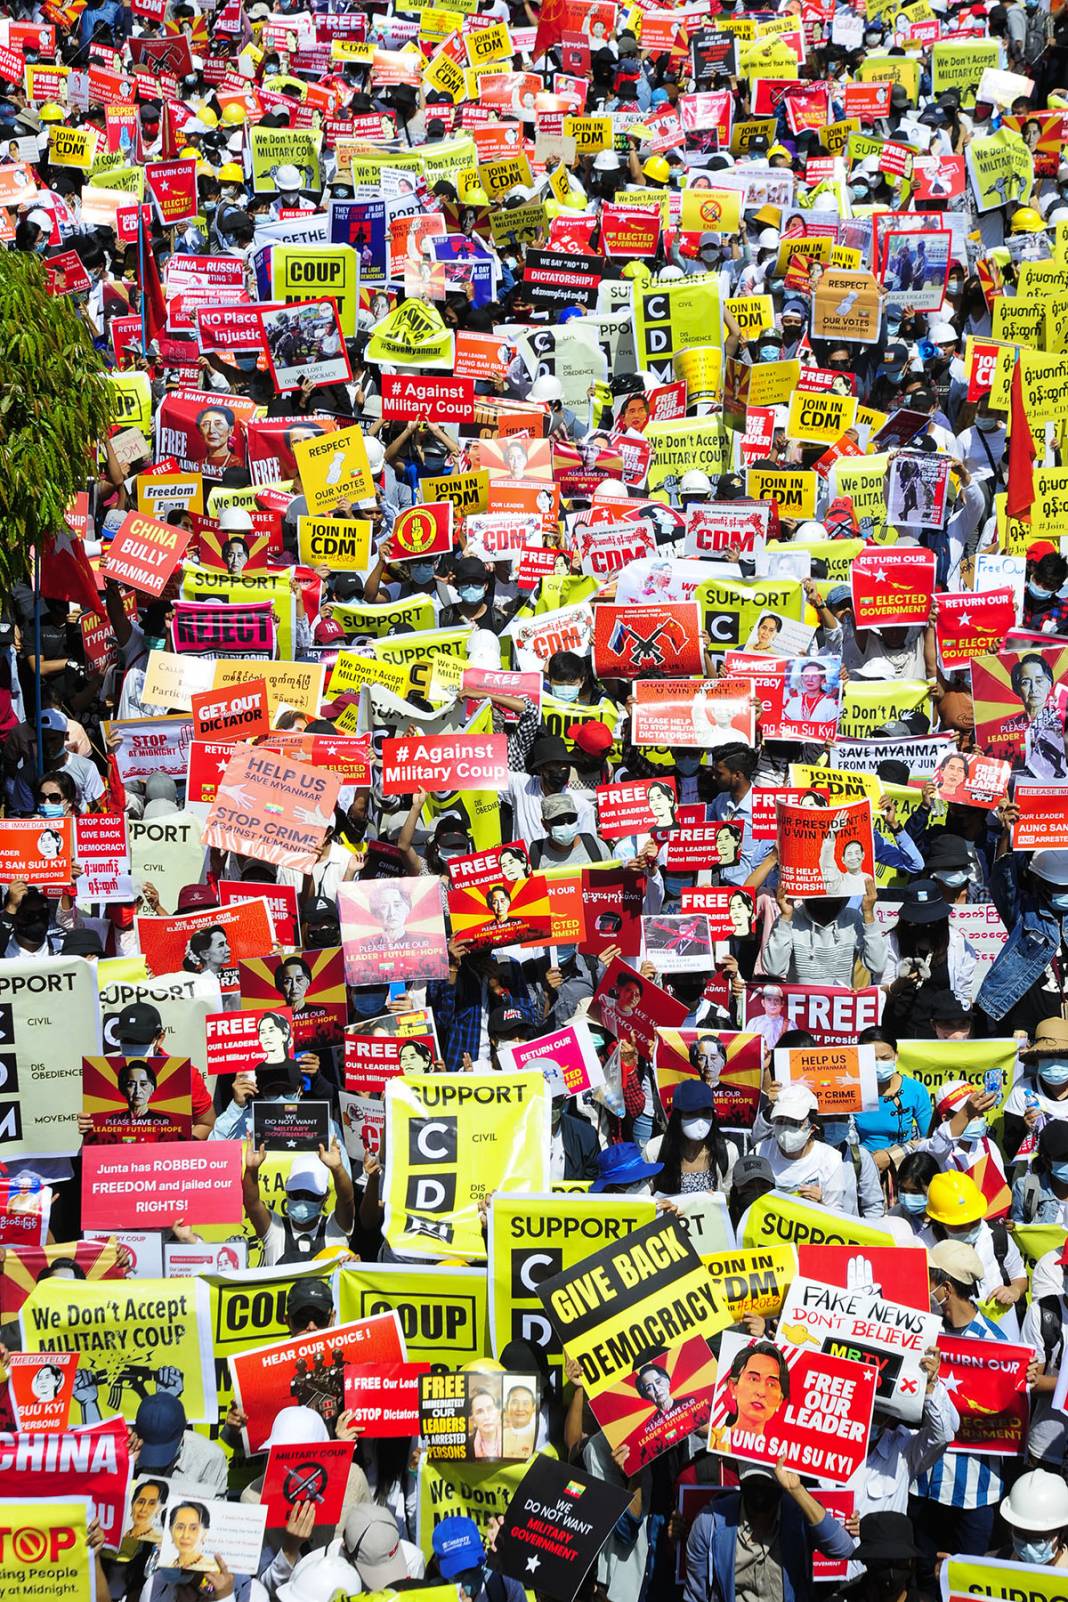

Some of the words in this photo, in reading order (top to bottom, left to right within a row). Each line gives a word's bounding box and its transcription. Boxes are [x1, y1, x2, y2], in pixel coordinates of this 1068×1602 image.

[316, 15, 359, 29] FREE
[491, 30, 501, 39] IN
[476, 39, 501, 55] CDM
[936, 58, 949, 67] We
[972, 54, 996, 65] Accept
[939, 67, 975, 79] MILITARY
[355, 117, 379, 127] FREE
[76, 135, 86, 144] IN
[255, 134, 269, 146] We
[151, 169, 175, 178] RETURN
[490, 170, 523, 189] CDM
[618, 232, 653, 241] ELECTED
[169, 260, 197, 271] CHINA
[207, 262, 241, 273] RUSSIA
[290, 263, 342, 282] COUP
[531, 272, 593, 285] DICTATORSHIP!
[828, 280, 868, 289] RESPECT
[648, 297, 665, 318] C
[201, 313, 221, 325] NO
[225, 311, 258, 323] Place
[842, 318, 869, 327] VOTES
[650, 332, 667, 350] D
[800, 371, 832, 384] FREE
[405, 383, 464, 398] Against
[655, 391, 678, 404] FREE
[384, 398, 431, 412] Military
[434, 400, 473, 415] Coup
[161, 427, 187, 460] FREE
[309, 437, 351, 458] RESPECT
[696, 434, 729, 448] Accept
[650, 451, 699, 465] MILITARY
[252, 457, 281, 485] FREE
[147, 486, 194, 496] Freedom
[315, 489, 334, 500] OUR
[336, 479, 365, 496] VOTES
[130, 519, 178, 549] CHINA
[484, 529, 526, 550] CDM
[697, 530, 754, 551] CDM
[120, 539, 167, 565] BULLY
[521, 552, 554, 563] FREE
[105, 558, 164, 588] MYANMAR
[196, 572, 279, 587] SUPPORT
[876, 594, 927, 605] ELECTED
[946, 598, 984, 608] RETURN
[986, 595, 1008, 605] OUR
[860, 606, 927, 616] GOVERNMENT
[178, 611, 270, 644] REJECT
[533, 627, 580, 659] CDM
[199, 703, 230, 721] GET
[233, 693, 261, 712] OUT
[200, 709, 262, 733] DICTATOR
[779, 723, 798, 735] San
[133, 735, 167, 748] STOP
[414, 743, 493, 760] Against
[839, 746, 873, 759] SAVE
[386, 763, 450, 782] Military
[457, 764, 504, 783] Coup
[838, 761, 867, 770] FROM
[248, 757, 297, 782] HELP
[301, 771, 326, 792] US
[244, 773, 269, 785] SAVE
[271, 780, 321, 801] MYANMAR
[598, 787, 646, 805] FREE
[753, 794, 800, 807] FREE
[210, 821, 257, 840] AGAINST
[217, 807, 259, 827] STOP
[263, 822, 318, 848] CRIME
[799, 815, 857, 830] PRESIDENT
[1019, 824, 1047, 832] AUNG
[78, 843, 125, 851] DEMOCRACY
[451, 856, 497, 877] FREE
[471, 874, 503, 886] LEADERS
[197, 916, 240, 929] GOVERNMENT
[207, 1017, 256, 1037] FREE
[345, 1041, 398, 1058] FREE
[519, 1043, 553, 1062] RETURN
[801, 1055, 829, 1066] HELP
[31, 1068, 84, 1080] OBEDIENCE
[410, 1084, 527, 1106] SUPPORT
[417, 1123, 449, 1159] C
[96, 1163, 128, 1174] Junta
[131, 1162, 151, 1173] has
[153, 1159, 207, 1171] ROBBED
[210, 1159, 227, 1169] our
[92, 1180, 156, 1194] FREEDOM
[158, 1179, 179, 1191] and
[181, 1179, 210, 1193] jailed
[213, 1179, 232, 1189] our
[136, 1199, 188, 1213] RIGHTS!
[511, 1216, 637, 1239] SUPPORT
[551, 1264, 618, 1325] GIVE
[612, 1225, 689, 1289] BACK
[32, 1307, 62, 1330] We
[67, 1301, 120, 1327] Don't
[125, 1295, 187, 1321] Accept
[803, 1286, 862, 1316] FAKE
[868, 1302, 926, 1334] NEWS
[580, 1282, 719, 1379] DEMOCRACY
[792, 1307, 846, 1329] DON'T
[851, 1316, 925, 1351] BELIEVE
[39, 1328, 126, 1353] MILITARY
[133, 1324, 186, 1347] COUP
[262, 1349, 297, 1367] HEAR
[299, 1342, 325, 1358] OUR
[328, 1327, 366, 1348] VOICE
[988, 1360, 1020, 1374] OUR
[422, 1375, 465, 1398] FREE
[803, 1370, 856, 1398] FREE
[17, 1403, 42, 1417] SUU
[422, 1398, 465, 1409] IMMEDIATELY
[804, 1392, 853, 1419] OUR
[355, 1408, 381, 1420] STOP
[432, 1408, 455, 1418] OUR
[423, 1418, 466, 1434] LEADERS
[783, 1404, 865, 1443] LEADER
[431, 1434, 466, 1445] ARRESTED
[0, 1431, 118, 1474] CHINA
[275, 1450, 318, 1461] MILITARY
[427, 1445, 466, 1460] PERSONS
[721, 1429, 765, 1452] AUNG
[768, 1436, 801, 1460] SAN
[802, 1446, 823, 1467] SU
[824, 1452, 854, 1476] KYI
[430, 1480, 455, 1504] We
[460, 1482, 511, 1505] Don't
[556, 1499, 573, 1515] WE
[524, 1499, 540, 1514] DO
[540, 1505, 563, 1526] NOT
[564, 1513, 593, 1535] WANT
[526, 1518, 574, 1545] MILITARY
[510, 1527, 578, 1563] GOVERNMENT
[30, 1567, 78, 1582] People
